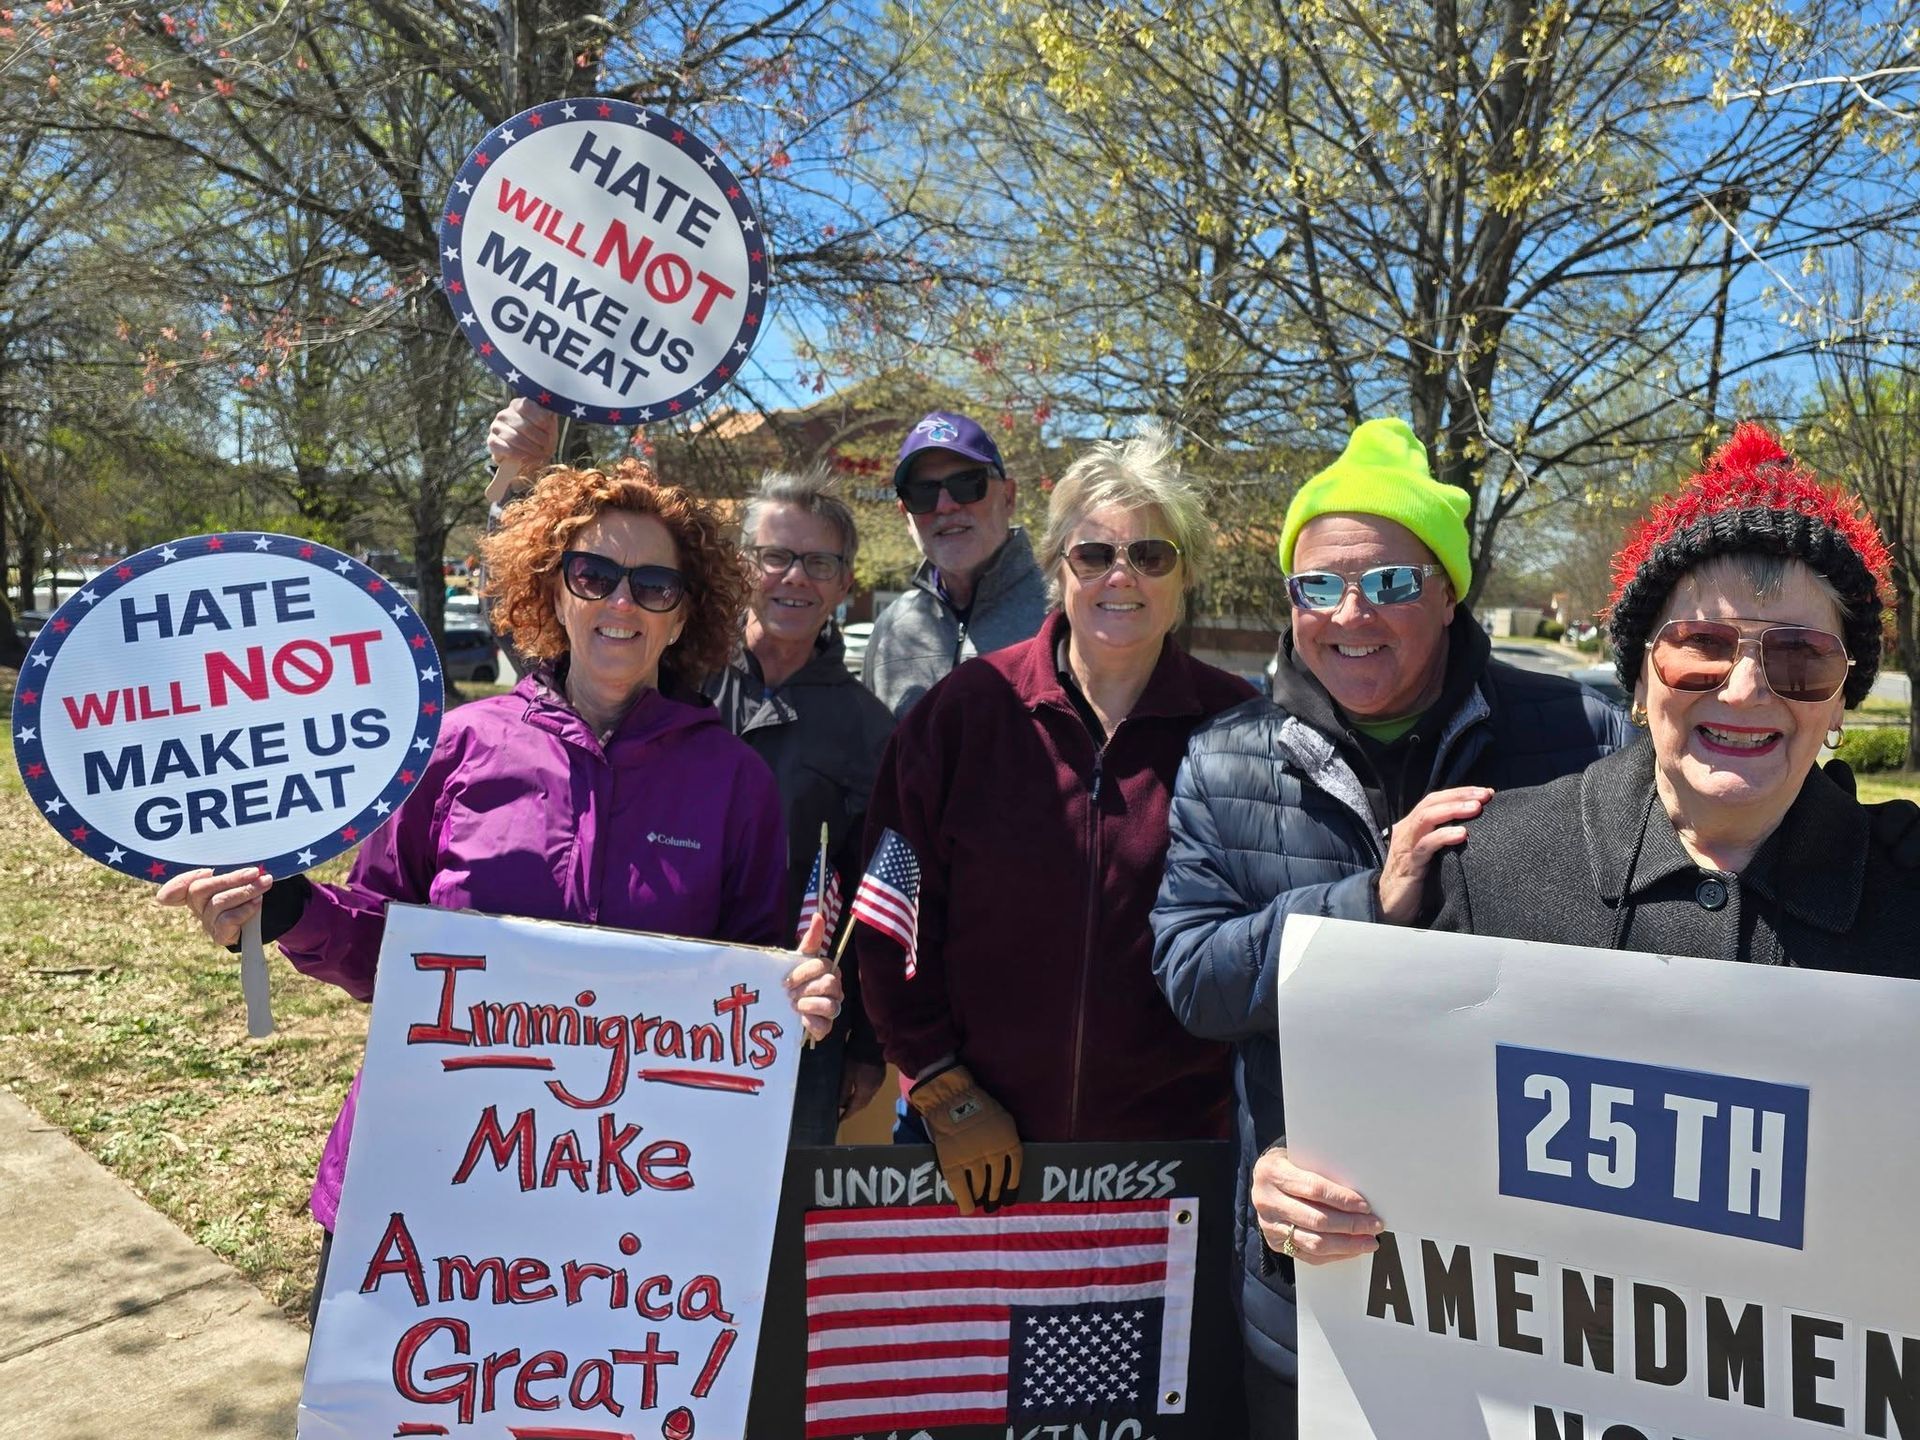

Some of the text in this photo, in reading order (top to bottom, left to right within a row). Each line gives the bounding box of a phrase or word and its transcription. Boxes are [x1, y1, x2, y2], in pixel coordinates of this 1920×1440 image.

[570, 131, 721, 248] HATE
[476, 231, 694, 374] MAKE US
[497, 177, 735, 325] WILL NOT
[490, 295, 649, 396] GREAT
[120, 576, 315, 643] HATE
[62, 630, 382, 730] WILL NOT
[83, 708, 391, 795] MAKE US
[134, 765, 355, 841] GREAT
[657, 833, 701, 850] Columbia
[406, 952, 783, 1109] Immigrants
[1040, 1160, 1183, 1203] DURESS
[1523, 1073, 1786, 1221] 25TH
[359, 1212, 738, 1324] America
[392, 1317, 738, 1440] Great!
